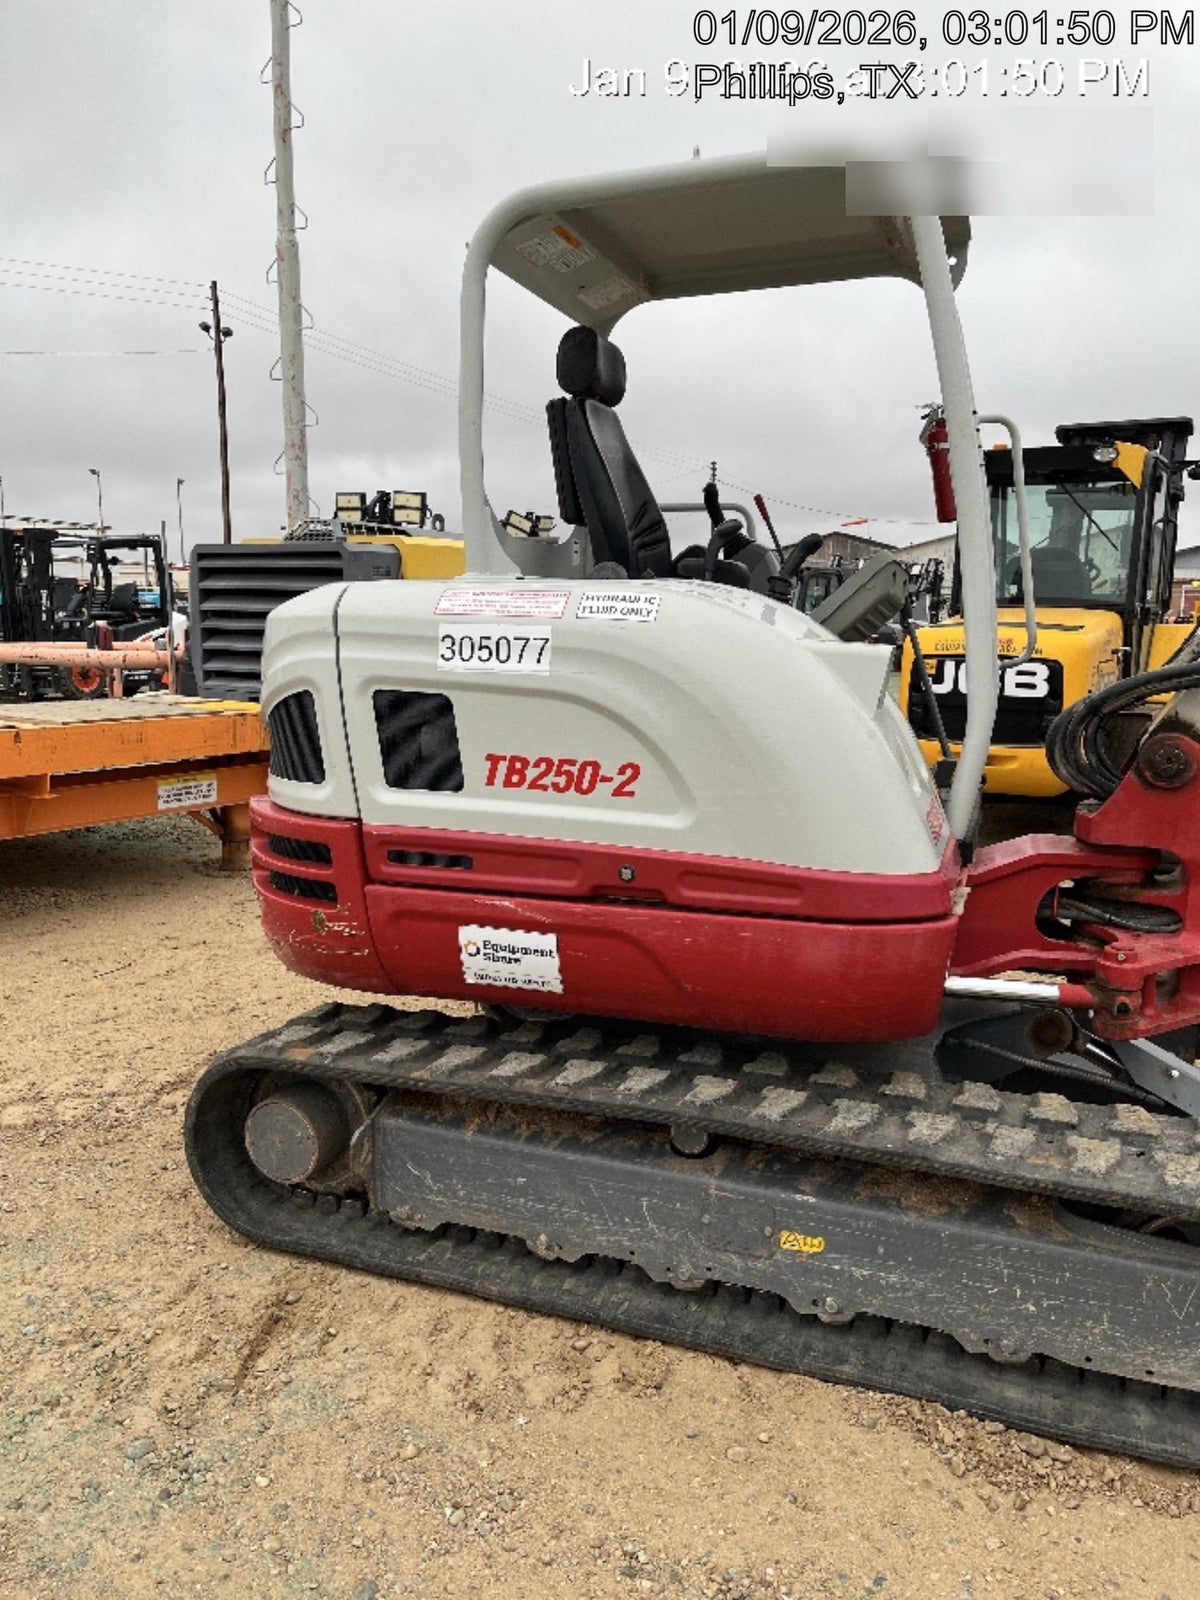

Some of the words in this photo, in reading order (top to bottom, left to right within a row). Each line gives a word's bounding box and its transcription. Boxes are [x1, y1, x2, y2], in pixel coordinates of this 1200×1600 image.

[440, 634, 550, 664] 305077
[484, 753, 641, 798] TB250-2
[482, 939, 556, 959] Equipment
